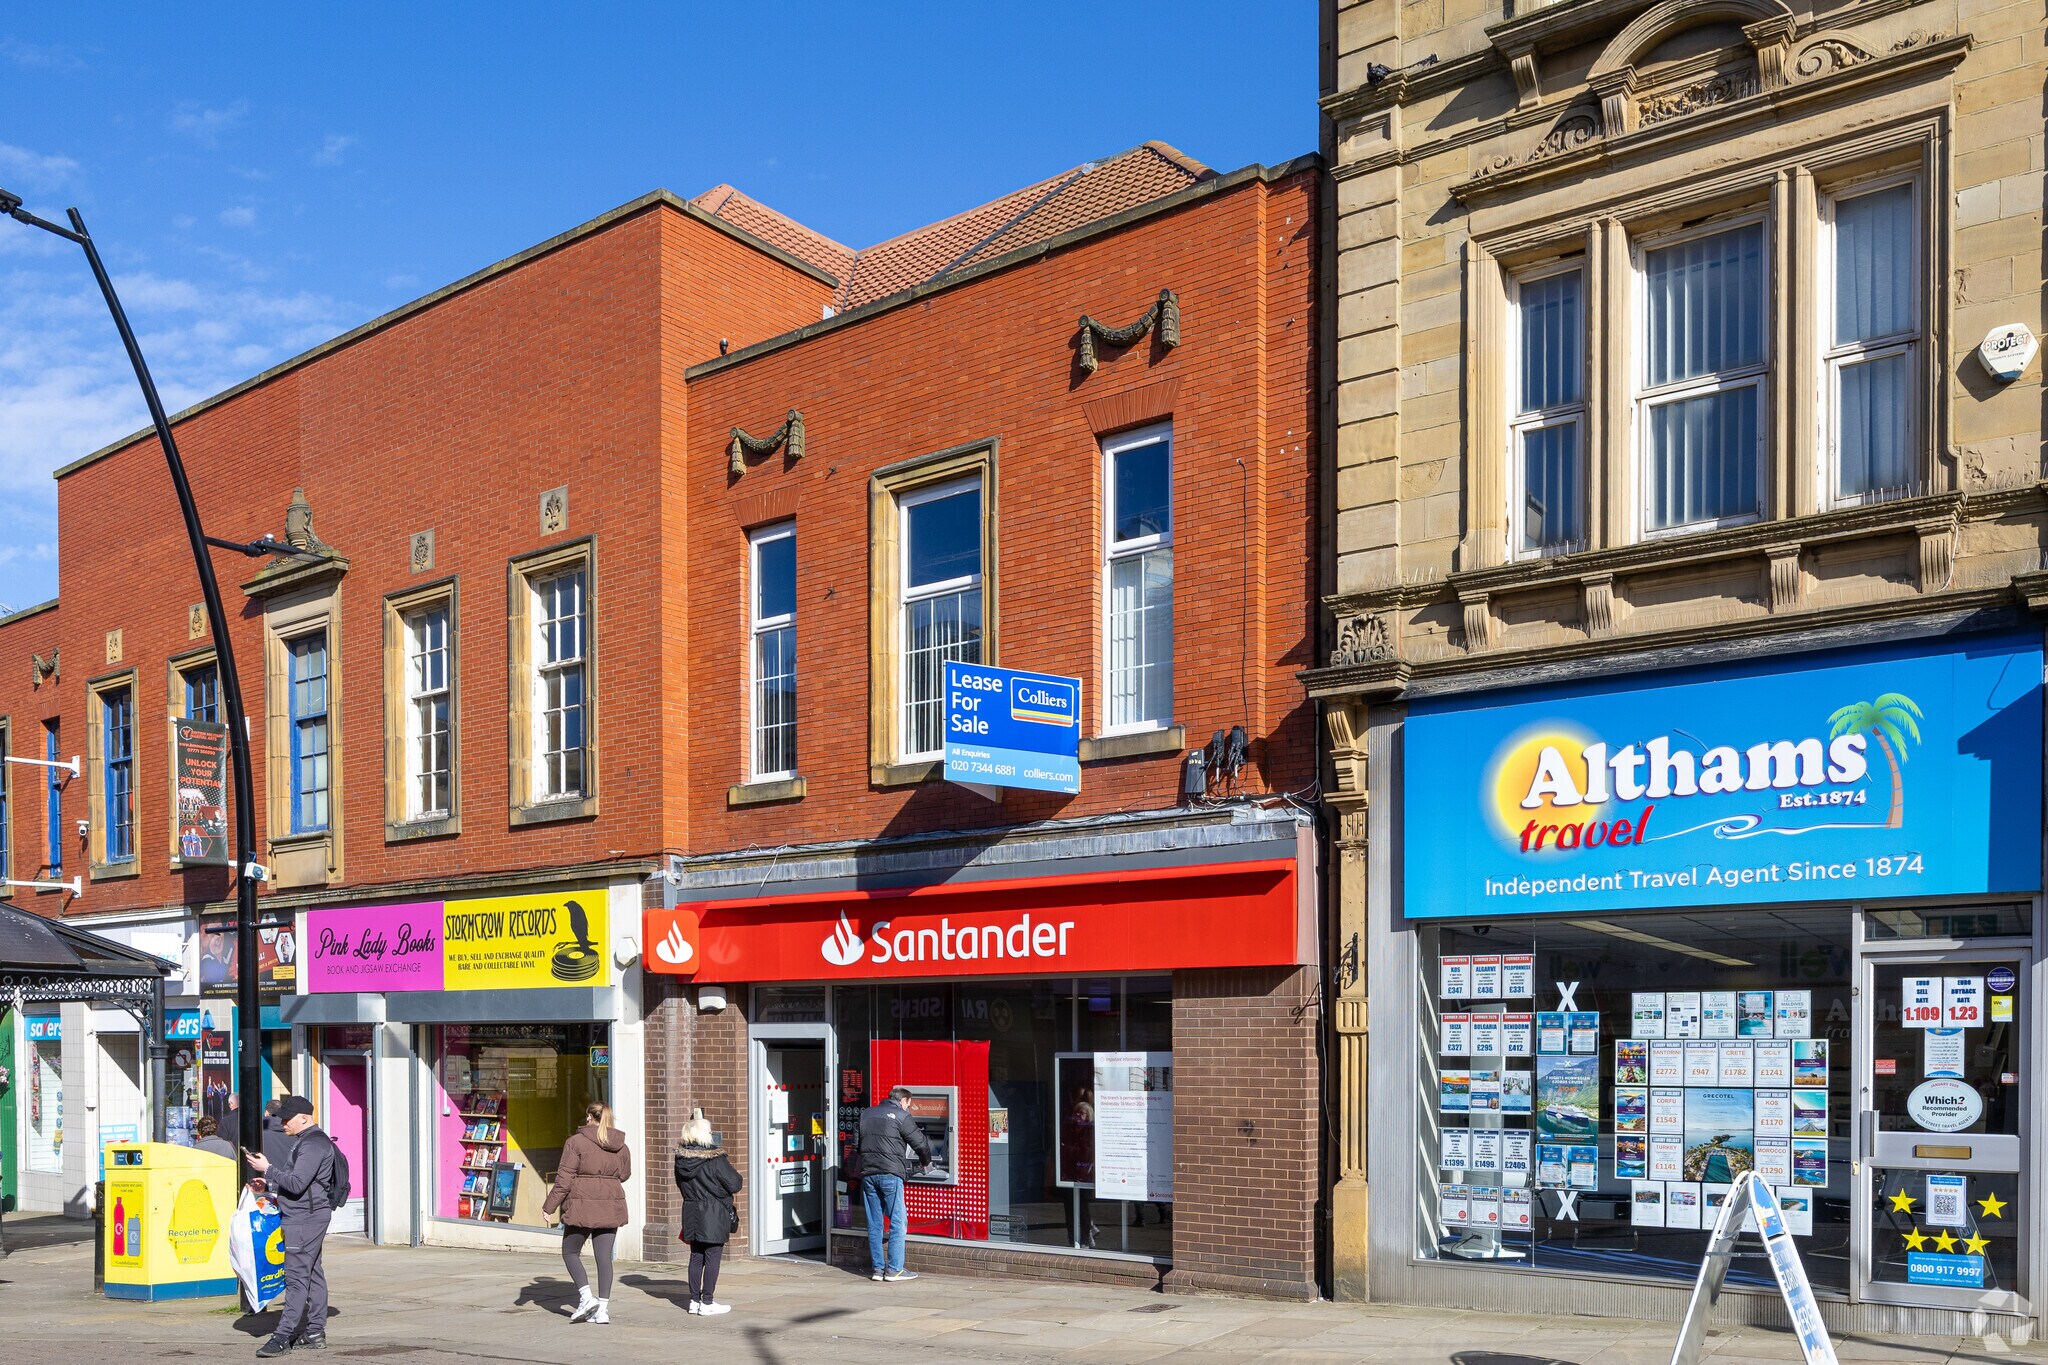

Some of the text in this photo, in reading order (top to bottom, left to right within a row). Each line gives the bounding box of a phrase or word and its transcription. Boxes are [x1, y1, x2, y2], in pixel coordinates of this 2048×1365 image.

[1985, 333, 2029, 351] PROTECT
[951, 669, 1003, 693] Lease
[952, 692, 981, 712] For
[1018, 687, 1067, 708] Colliers
[951, 714, 989, 735] Sale
[961, 749, 991, 759] Enquiries
[185, 758, 217, 769] UNLOCK
[951, 760, 1016, 776] 020 7344 6881
[1521, 732, 1868, 809] Althams
[191, 768, 213, 778] YOUR
[1023, 768, 1073, 782] colliers.com
[1779, 788, 1867, 810] Est.1874
[1518, 804, 1655, 852] travel
[1484, 854, 1925, 897] Independent Travel Agent Since 1874
[445, 908, 557, 942] STORMCROW RECORDS
[315, 922, 436, 961] Pink Lady Books
[871, 914, 1075, 963] Santander
[449, 953, 457, 962] WE
[470, 952, 483, 961] SELL
[484, 952, 495, 961] AND
[494, 951, 522, 960] EXCHANGE
[523, 950, 546, 959] QUALITY
[327, 962, 421, 975] BOOK AND JIGSAW EXCHANGE
[458, 960, 536, 971] RARE AND COLLECTABLE VINYL
[1478, 986, 1494, 994] £436
[1904, 1006, 1940, 1020] 1.109
[1948, 1006, 1978, 1020] 1.23
[919, 1102, 947, 1111] Santander
[1924, 1095, 1965, 1105] Which?
[1957, 1115, 1973, 1127] AGENTS
[1444, 1159, 1465, 1167] £1399
[1474, 1160, 1495, 1168] £1499
[1504, 1161, 1526, 1169] £2409
[168, 1229, 200, 1237] Recycle
[1910, 1264, 1980, 1277] 0800 917 9997
